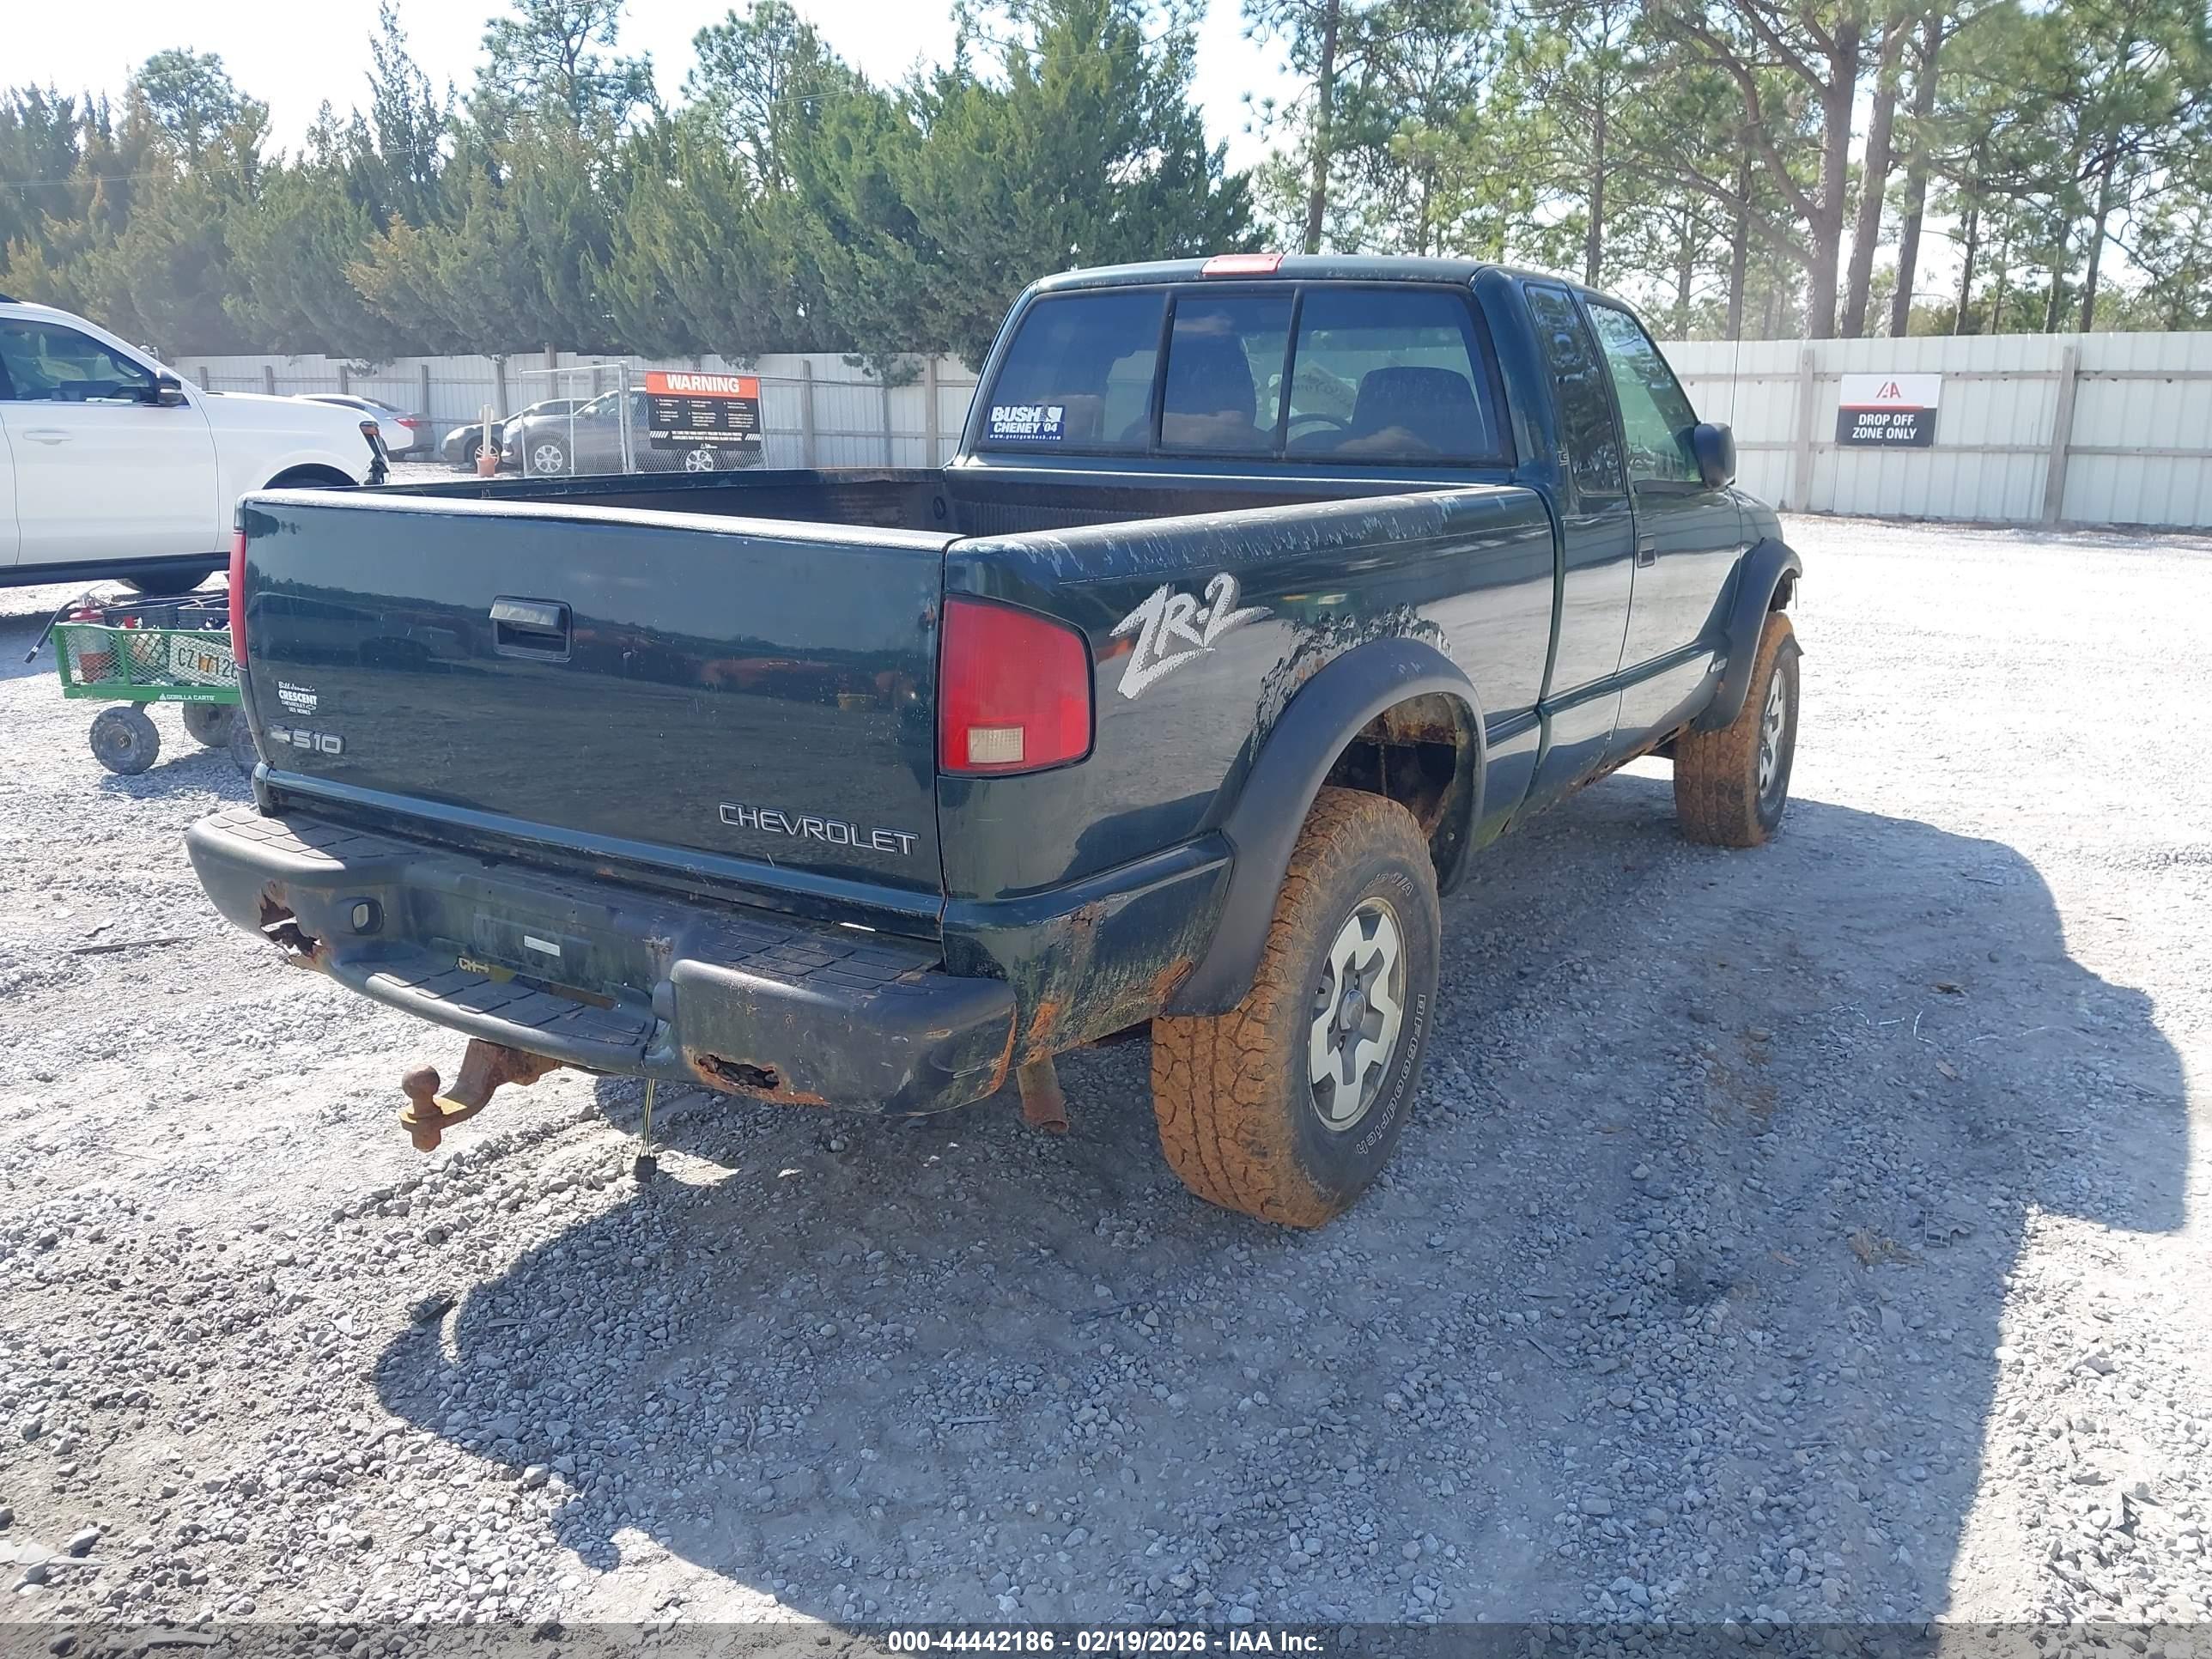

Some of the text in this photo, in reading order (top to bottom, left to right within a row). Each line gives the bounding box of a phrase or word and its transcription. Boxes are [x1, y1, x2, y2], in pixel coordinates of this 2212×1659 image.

[666, 374, 739, 392] WARNING
[991, 406, 1042, 422] BUSH
[1858, 414, 1915, 426] DROP OFF
[994, 422, 1058, 433] CHENEY '04
[1852, 427, 1917, 440] ZONE ONLY
[278, 690, 317, 705] CRESCENT
[293, 730, 342, 755] S10
[719, 802, 919, 855] CHEVROLET
